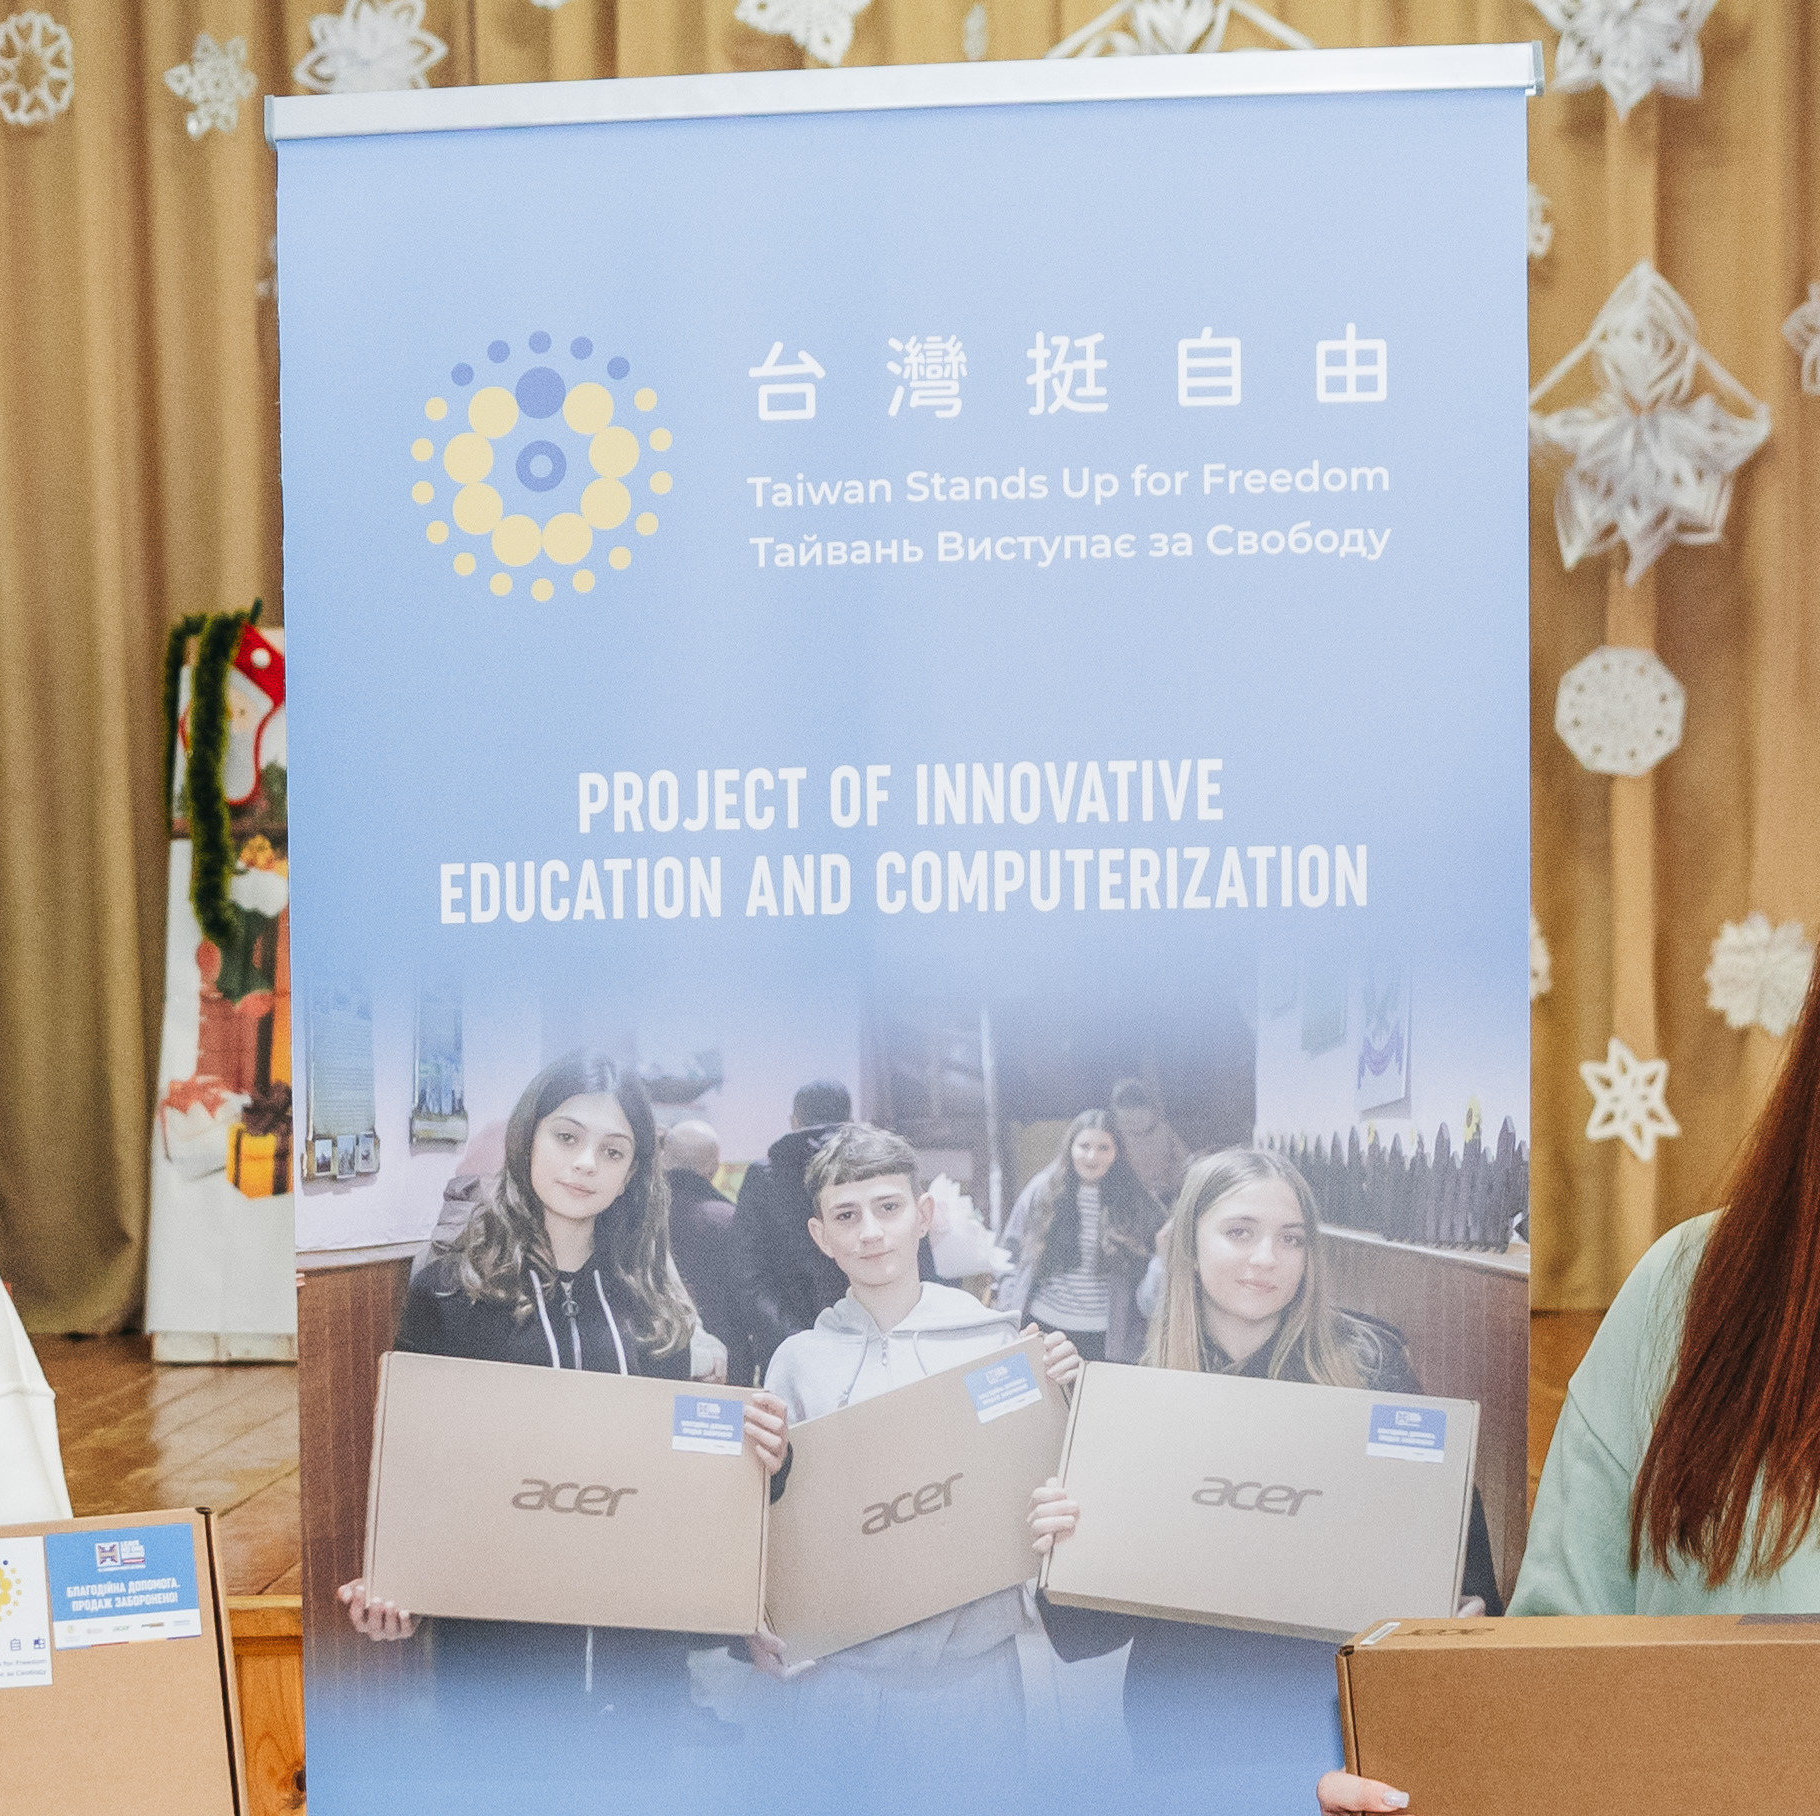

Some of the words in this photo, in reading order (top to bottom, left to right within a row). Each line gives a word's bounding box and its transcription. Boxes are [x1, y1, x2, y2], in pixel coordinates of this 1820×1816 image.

[749, 322, 1388, 422] 台灣挺自由
[747, 472, 891, 508] Taiwan
[906, 467, 1048, 502] Stands
[1062, 466, 1119, 505] Up
[1131, 463, 1189, 497] for
[1202, 459, 1390, 495] Freedom
[749, 533, 924, 568] Тайвань
[937, 530, 1137, 569] Виступає
[1148, 531, 1194, 558] за
[1205, 520, 1392, 562] Свободу
[578, 767, 807, 834] PROJECT
[830, 764, 892, 828] OF
[916, 758, 1224, 826] INNOVATIVE
[440, 856, 722, 924] EDUCATION
[745, 853, 851, 917] AND
[875, 844, 1368, 915] COMPUTERIZATION
[510, 1478, 638, 1518] acer
[860, 1472, 964, 1537] acer
[1191, 1477, 1325, 1518] acer
